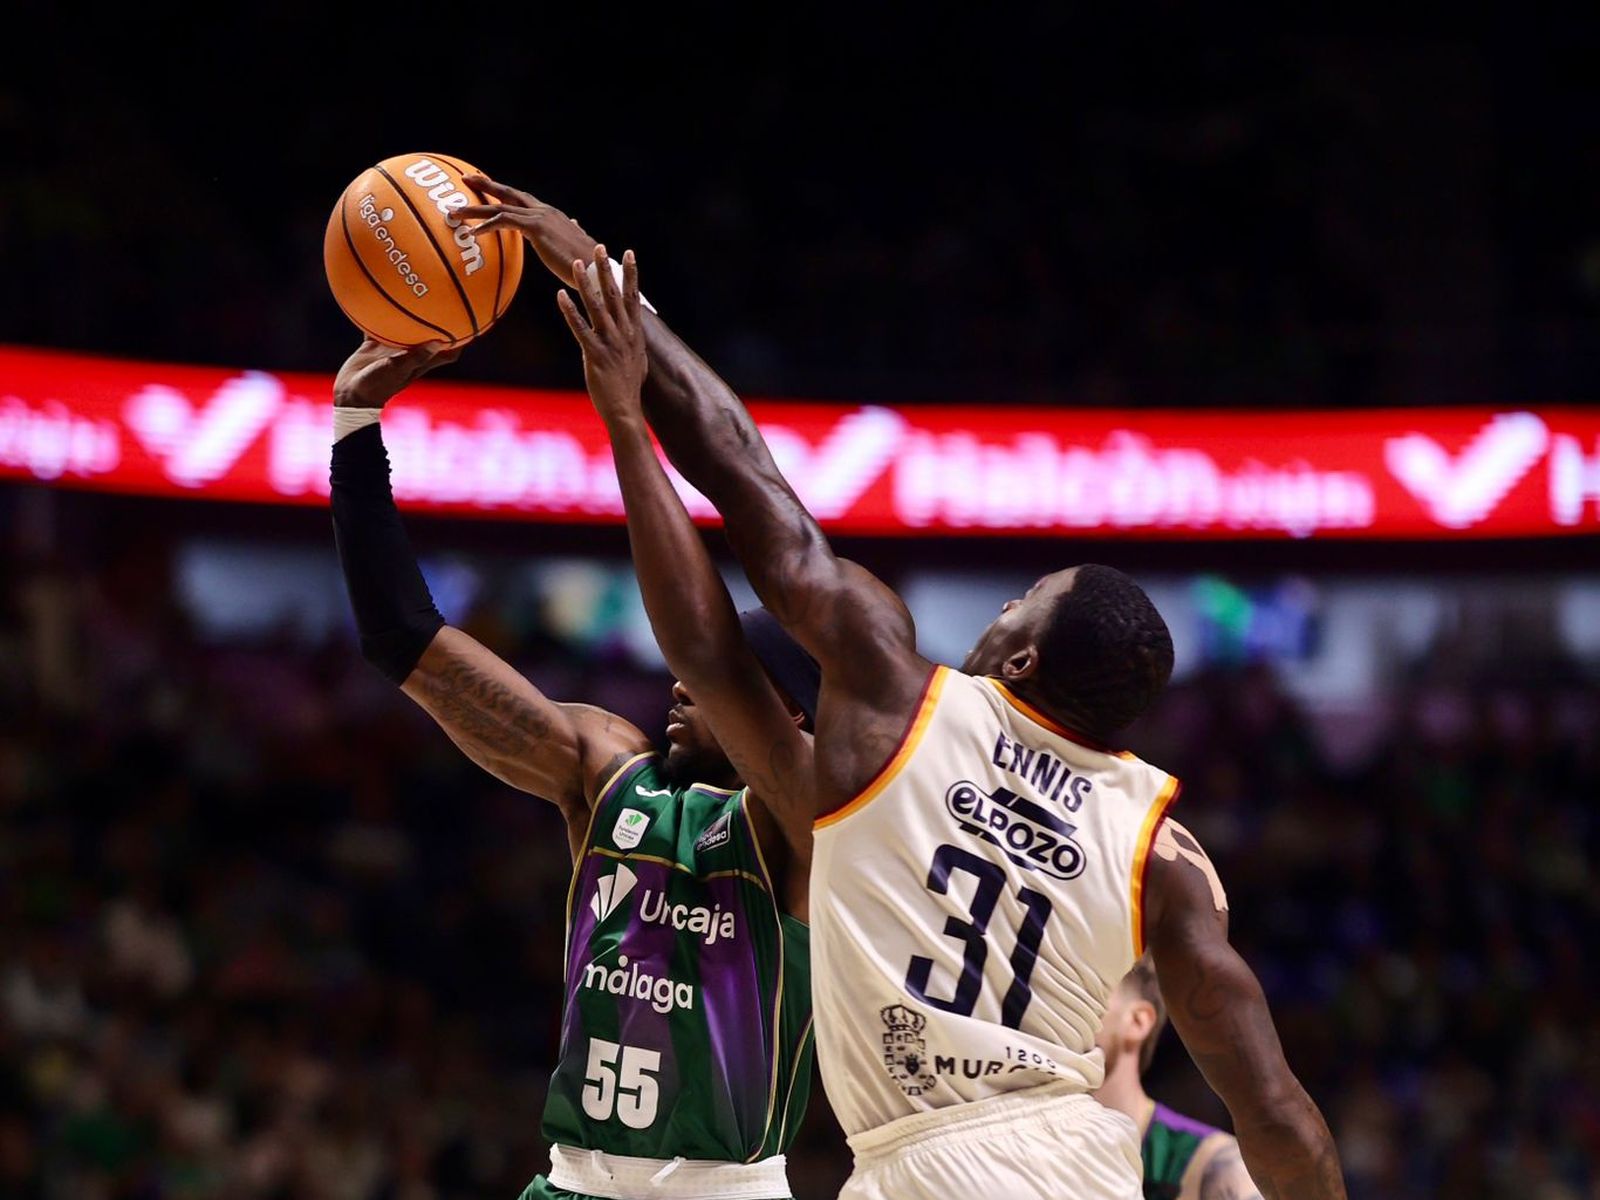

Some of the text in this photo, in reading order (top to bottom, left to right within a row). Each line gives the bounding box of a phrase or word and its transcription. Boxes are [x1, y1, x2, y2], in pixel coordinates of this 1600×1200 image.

[993, 731, 1092, 812] ENNIS
[640, 889, 735, 945] Uncaja
[905, 843, 1053, 1031] 31
[581, 1037, 661, 1130] 55
[934, 1055, 1056, 1079] MUR
